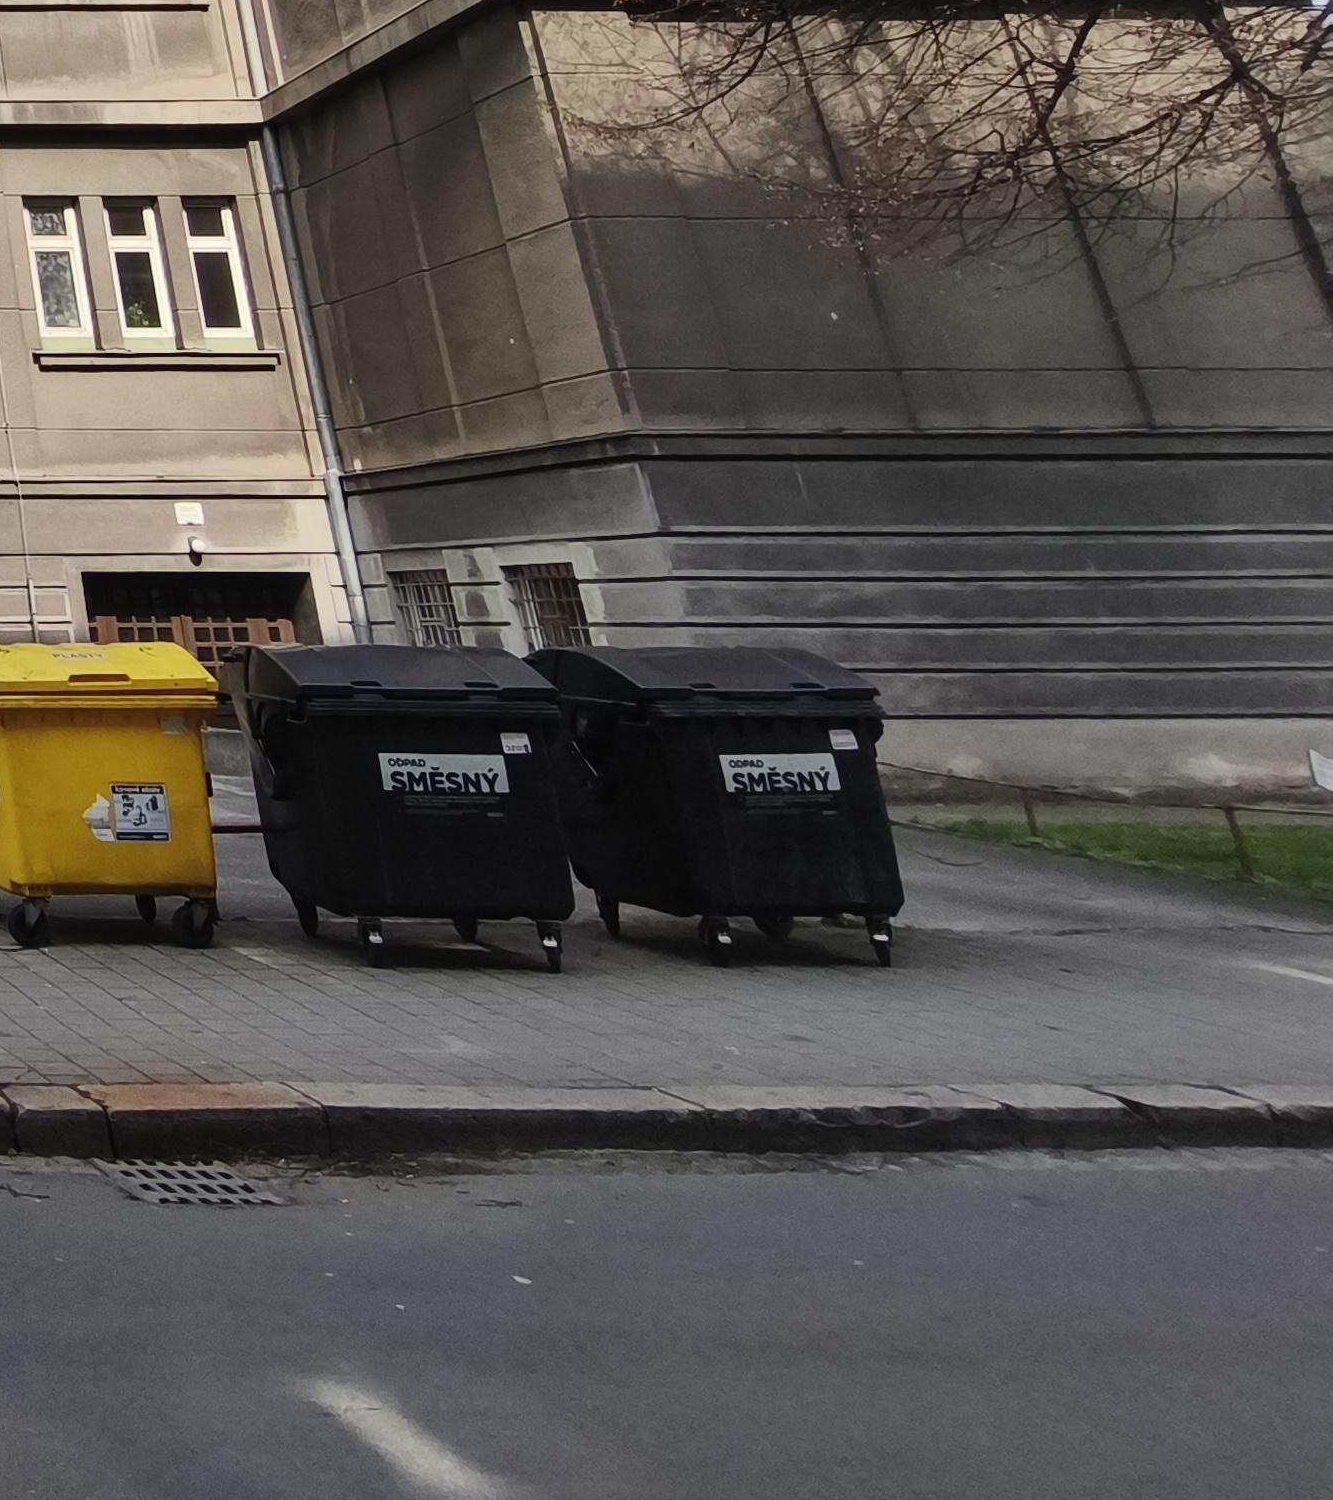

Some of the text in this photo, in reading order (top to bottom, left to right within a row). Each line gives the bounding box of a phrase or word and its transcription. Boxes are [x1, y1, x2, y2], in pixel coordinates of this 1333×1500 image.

[52, 652, 103, 660] PLASTY
[388, 757, 426, 767] ODPAD
[728, 759, 764, 768] ODPAD
[390, 766, 499, 793] SMĚSNÝ
[732, 766, 830, 793] SMĚSNÝ
